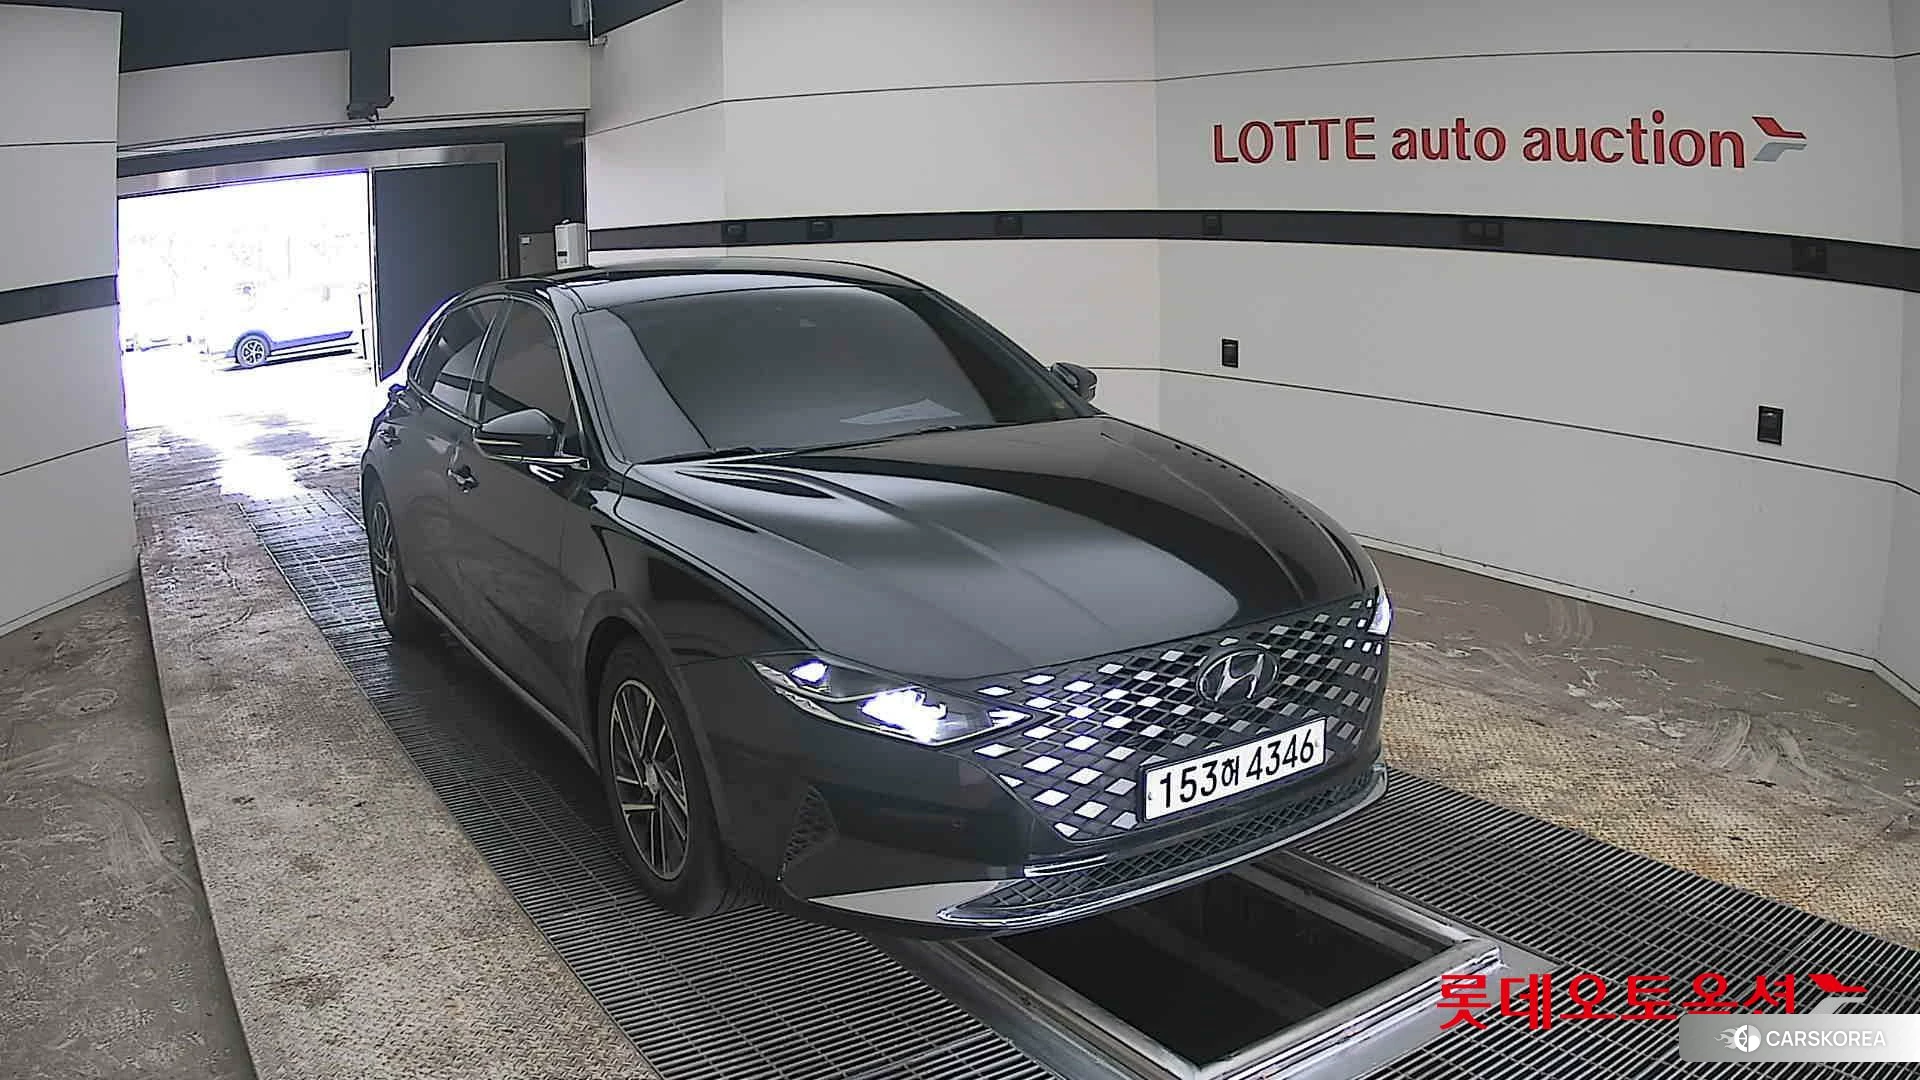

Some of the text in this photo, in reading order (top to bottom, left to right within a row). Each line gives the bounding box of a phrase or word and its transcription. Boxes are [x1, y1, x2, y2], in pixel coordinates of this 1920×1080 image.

[1214, 110, 1746, 168] LOTTE auto auction
[1246, 728, 1315, 781] 4346
